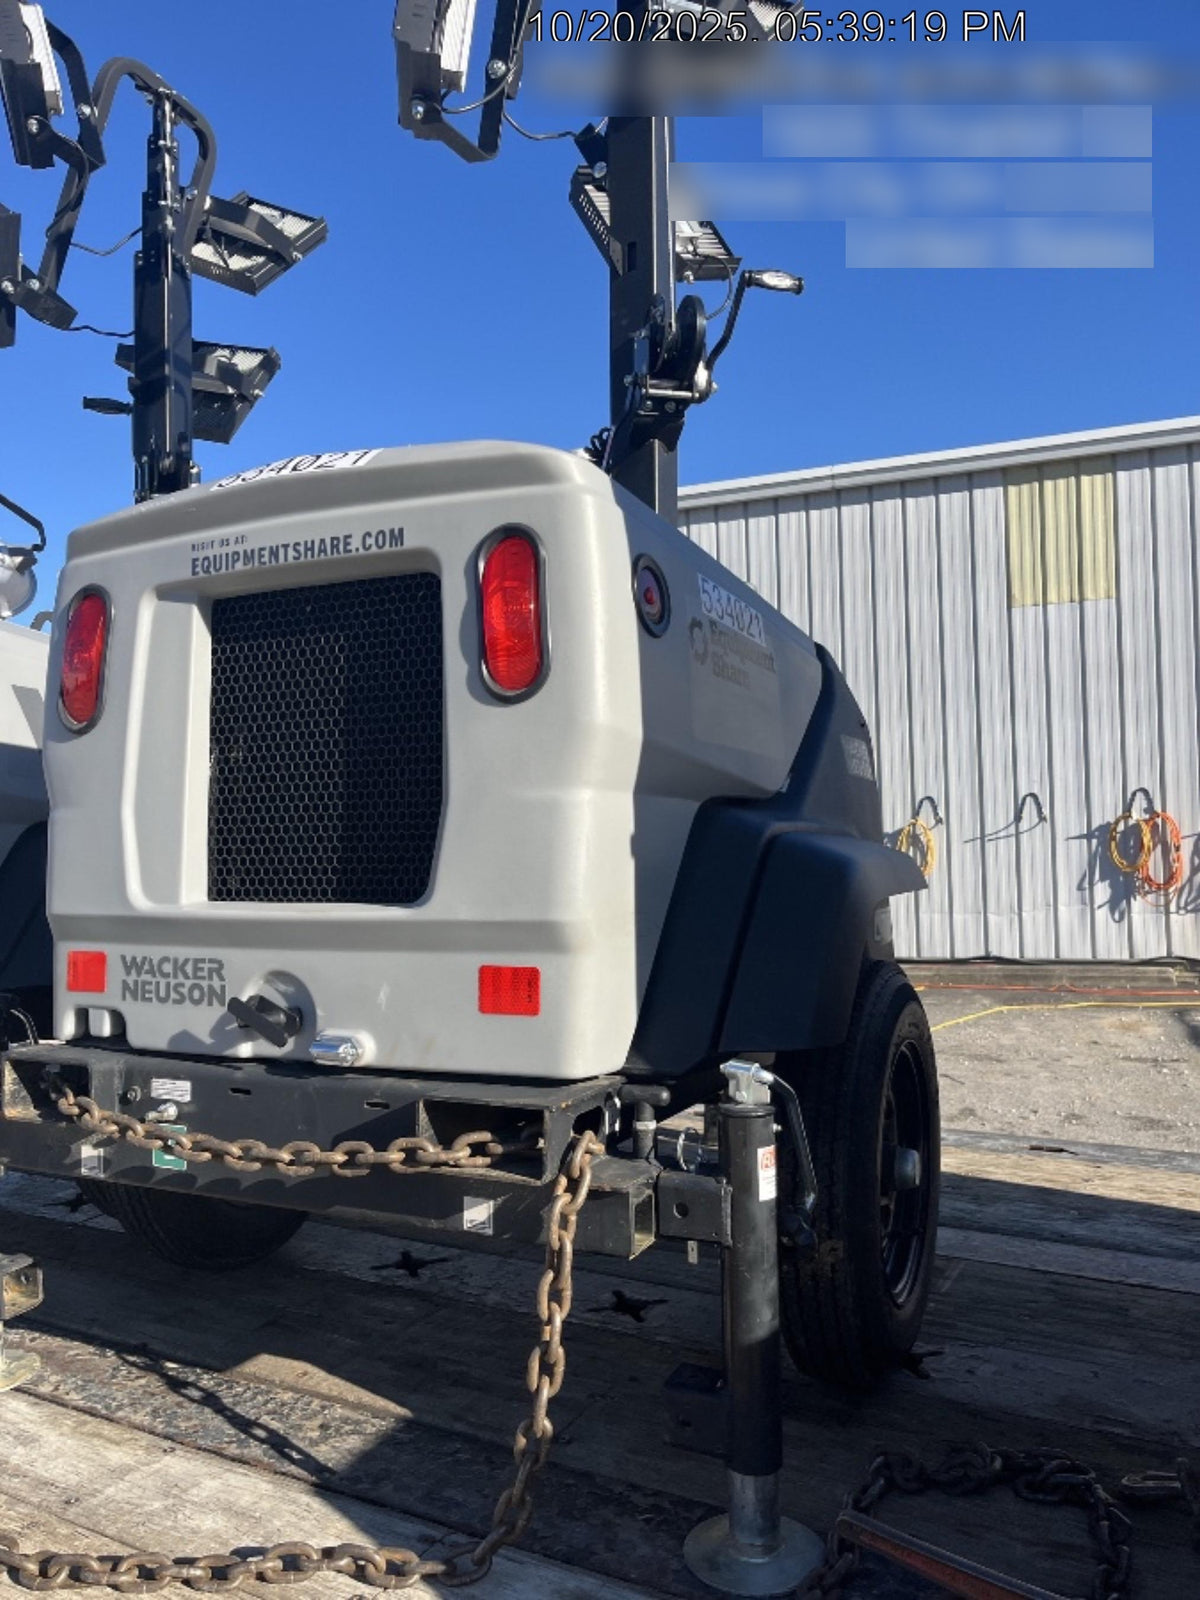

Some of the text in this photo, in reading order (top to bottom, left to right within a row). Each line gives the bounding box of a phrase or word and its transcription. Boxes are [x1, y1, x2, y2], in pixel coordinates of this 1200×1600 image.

[191, 527, 405, 577] EQUIPMENTSHARE.COM
[701, 578, 764, 643] 534021
[121, 955, 225, 982] WACKER
[121, 979, 226, 1007] NEUSON
